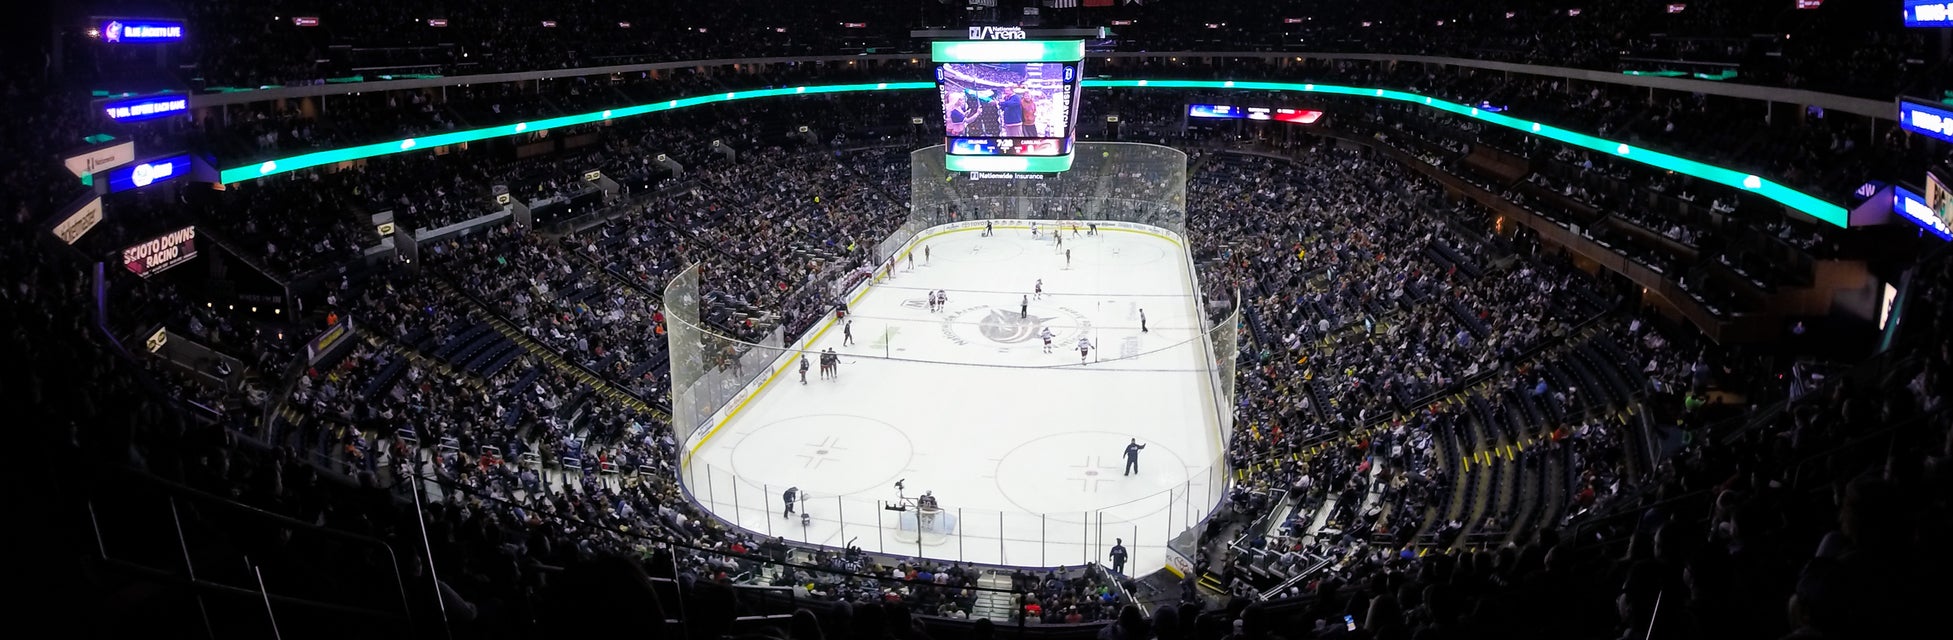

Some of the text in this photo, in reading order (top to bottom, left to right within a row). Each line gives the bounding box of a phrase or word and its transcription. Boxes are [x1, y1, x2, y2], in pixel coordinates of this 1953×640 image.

[125, 26, 180, 37] BLUE JACKETS LIVE
[981, 26, 1025, 40] Arena
[1063, 84, 1071, 128] DISPATCH
[124, 241, 160, 265] SCIOTO
[161, 225, 196, 250] DOWNS
[146, 246, 179, 269] RACINO
